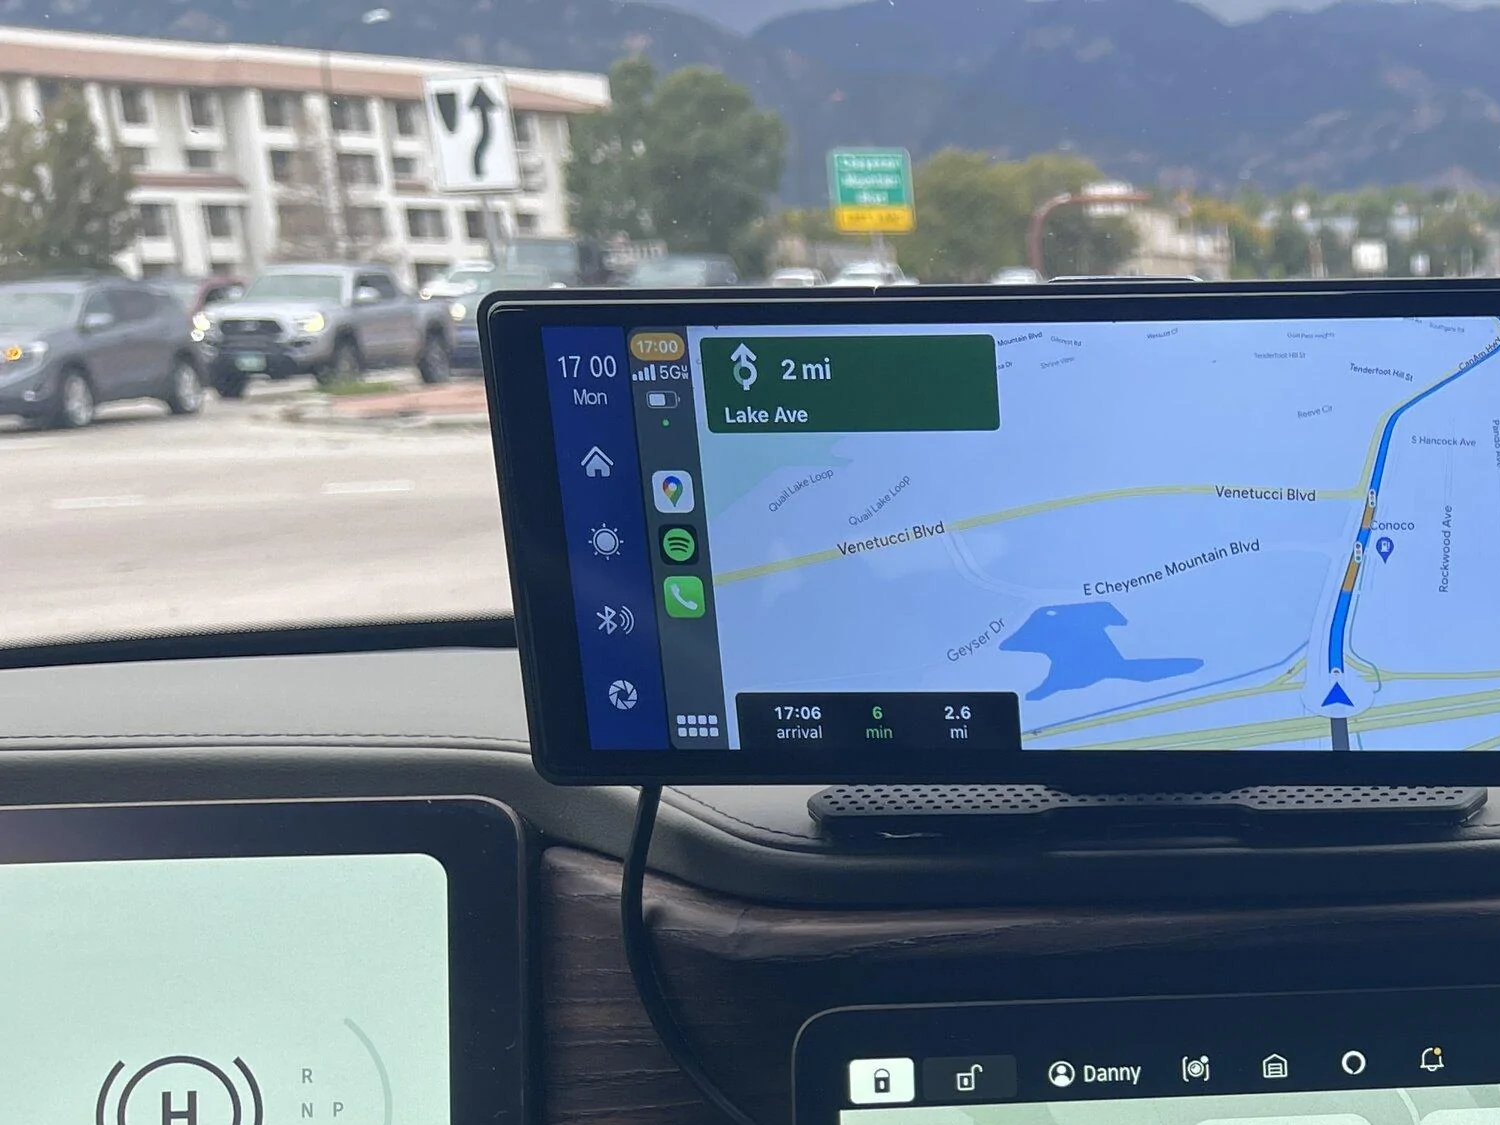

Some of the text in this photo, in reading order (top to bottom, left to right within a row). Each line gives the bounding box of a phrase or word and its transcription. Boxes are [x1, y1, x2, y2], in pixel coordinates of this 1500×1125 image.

[637, 340, 678, 353] 17:00
[997, 331, 1043, 347] Mountain Blvd
[558, 355, 617, 379] 17 00
[782, 358, 832, 381] 2 mi
[1458, 351, 1487, 372] CanAm
[1350, 362, 1413, 382] Tenderfoot Hill St
[573, 388, 608, 405] Mon
[725, 406, 808, 424] Lake Ave
[1411, 435, 1477, 447] S Hancock Ave
[1493, 419, 1500, 449] Pando
[768, 467, 834, 513] Quail Lake Loop
[1215, 485, 1316, 502] Venetucci Blvd
[848, 474, 911, 527] Quail Lake Loop
[1369, 520, 1415, 532] Conoco
[837, 520, 946, 557] Venetucci Blvd
[1438, 505, 1453, 593] Rockwood Ave
[1083, 539, 1261, 597] E Cheyenne Mountain Blvd
[946, 616, 1007, 663] Geyser Dr
[774, 706, 822, 721] 17:06
[872, 706, 883, 720] 6
[944, 706, 972, 720] 2.6
[776, 724, 823, 740] arrival
[866, 725, 894, 740] min
[949, 725, 968, 740] mi
[302, 1069, 313, 1084] R
[1083, 1062, 1141, 1086] Danny
[302, 1103, 314, 1118] N
[333, 1102, 344, 1117] P
